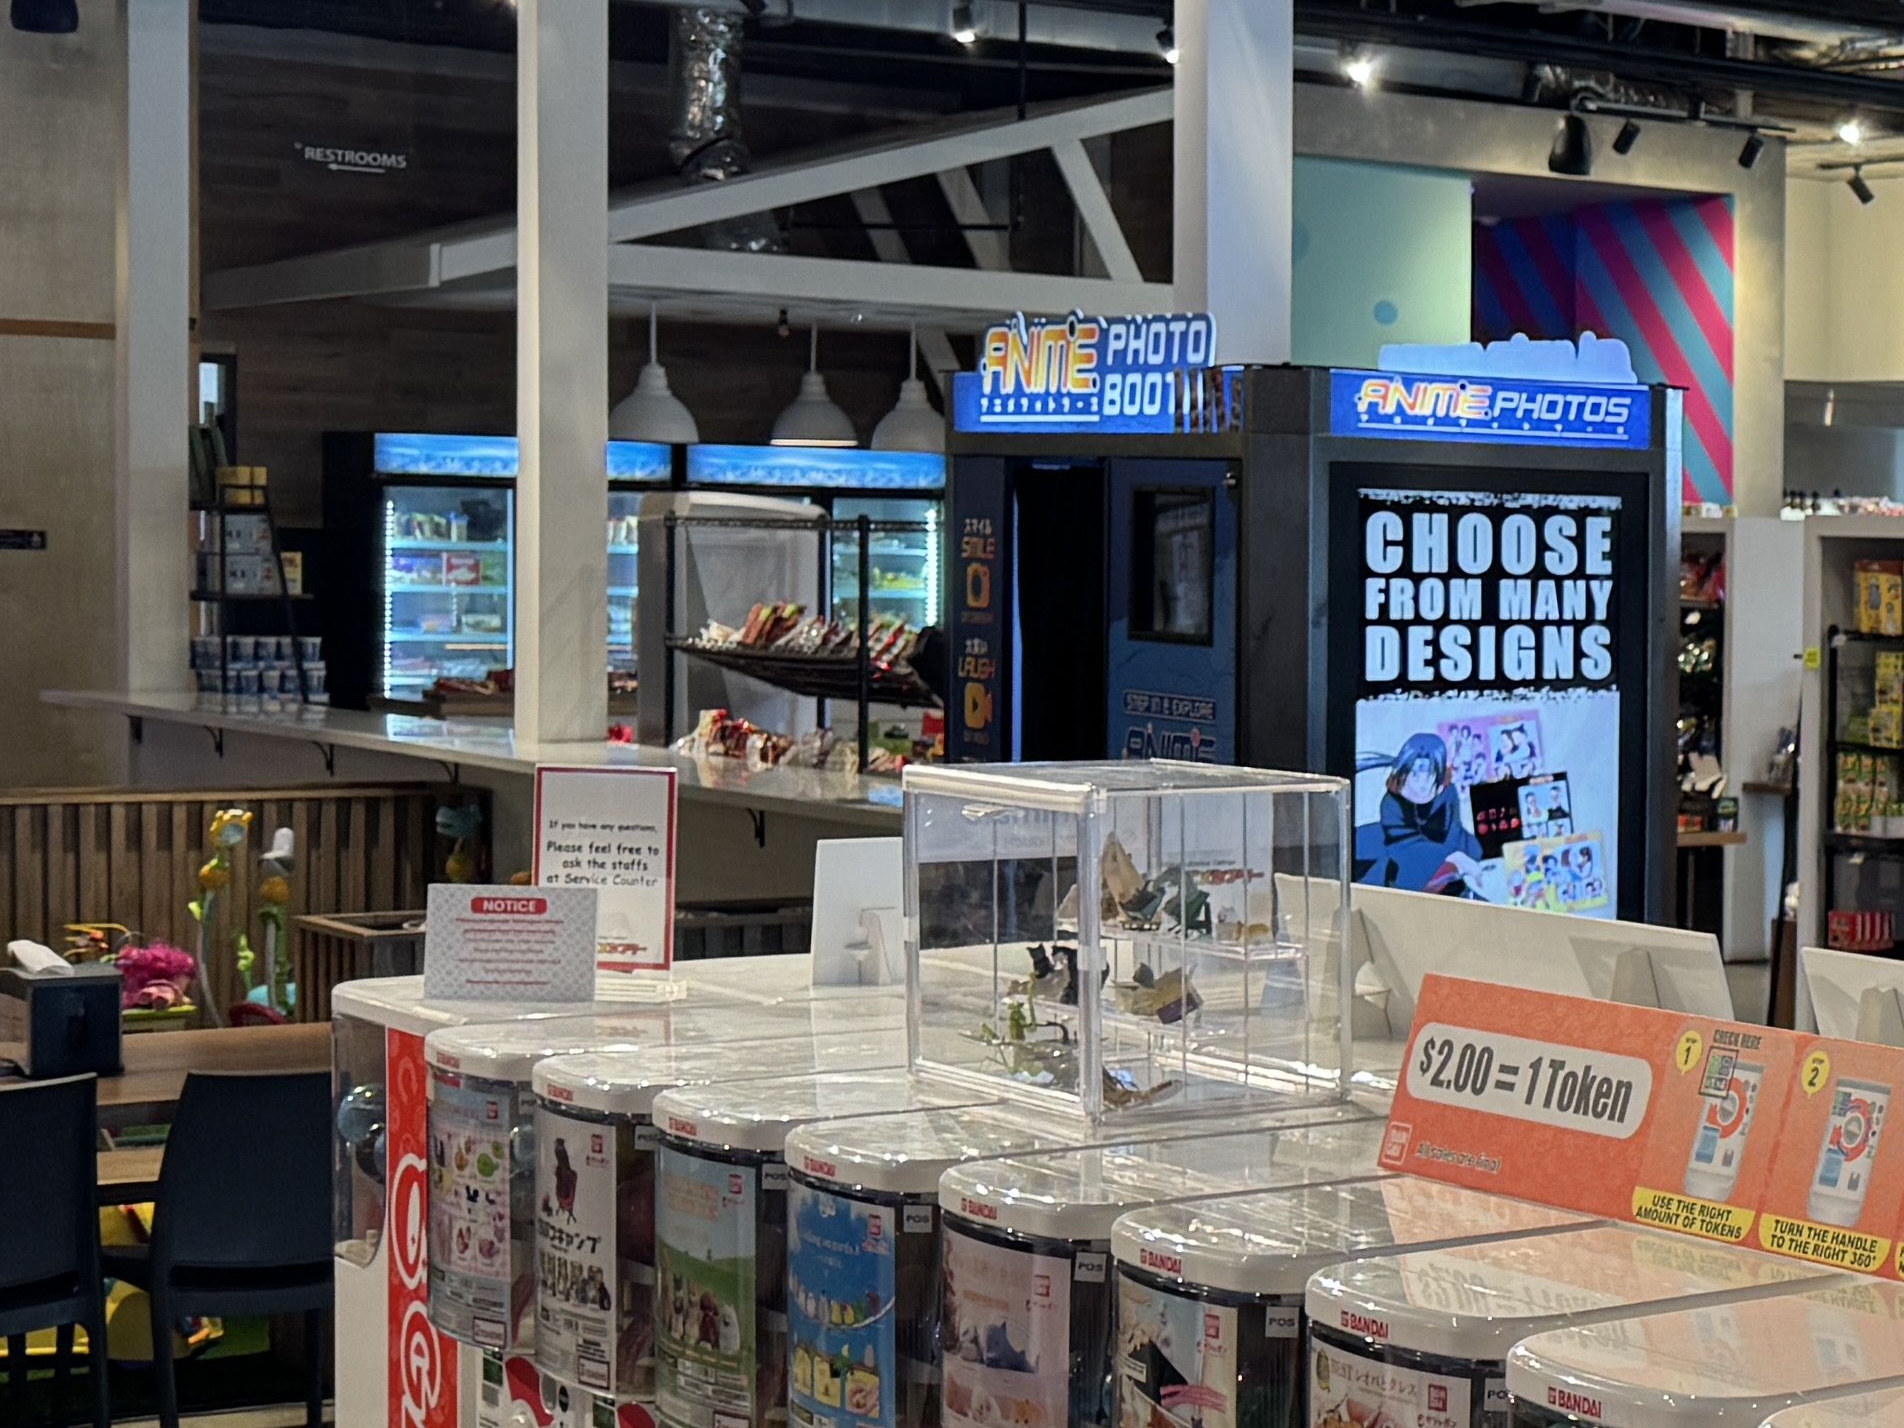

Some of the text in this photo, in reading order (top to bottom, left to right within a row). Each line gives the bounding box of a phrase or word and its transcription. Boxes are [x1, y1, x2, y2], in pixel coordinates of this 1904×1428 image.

[304, 147, 407, 169] RESTROOMS
[981, 317, 1206, 394] ANIME PHOTO
[1358, 381, 1630, 424] ANIME PHOTOS
[1366, 511, 1612, 573] CHOOSE
[1366, 578, 1612, 621] FROM MANY
[1365, 625, 1612, 681] DESIGNS
[547, 841, 659, 856] Please feel free to
[562, 857, 648, 871] ask the staffs
[547, 873, 658, 887] at Service Counter
[483, 899, 536, 913] NOTICE
[1419, 1036, 1633, 1124] $2.00 = 1 Token
[1557, 1390, 1601, 1417] BANDAI
